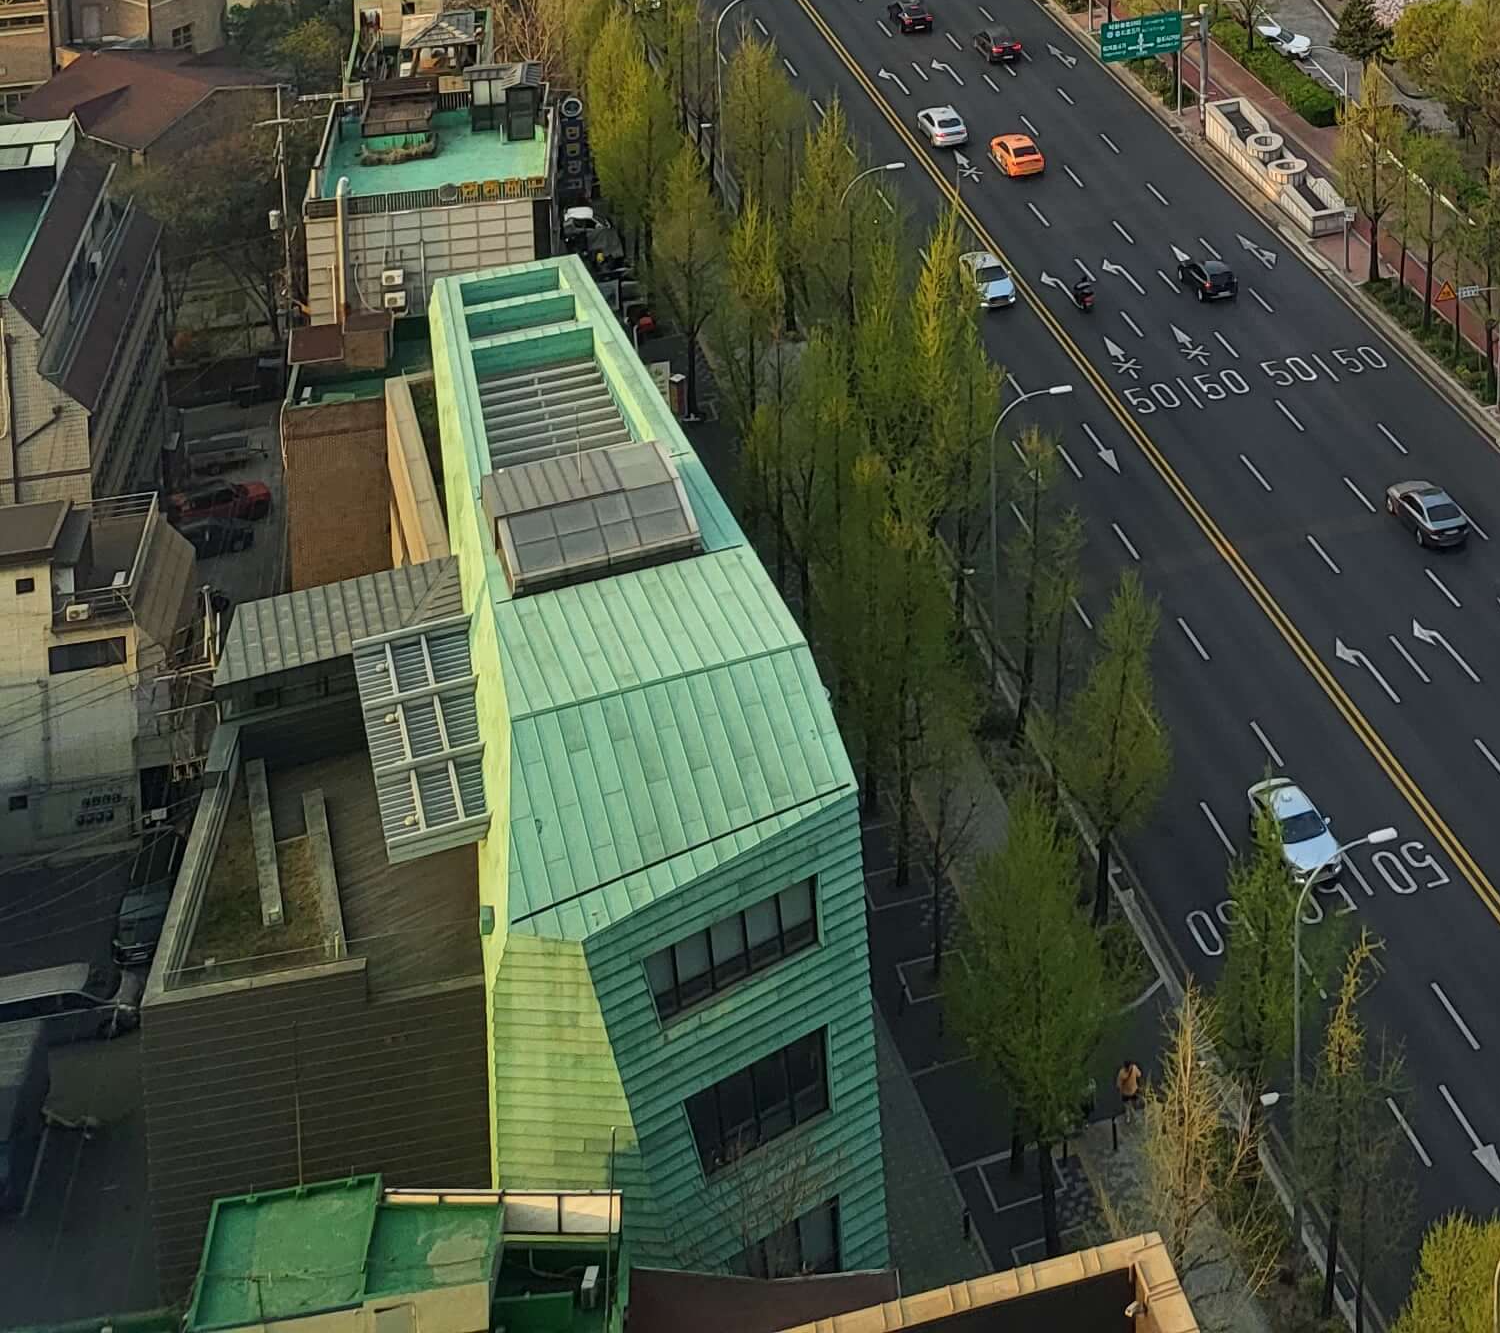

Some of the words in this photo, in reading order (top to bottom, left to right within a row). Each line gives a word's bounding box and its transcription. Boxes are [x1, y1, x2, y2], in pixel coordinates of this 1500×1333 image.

[1260, 356, 1318, 386] 50
[1331, 346, 1388, 373] 50
[1123, 383, 1182, 414] 50
[1193, 369, 1250, 400] 50
[1371, 841, 1450, 895] 50
